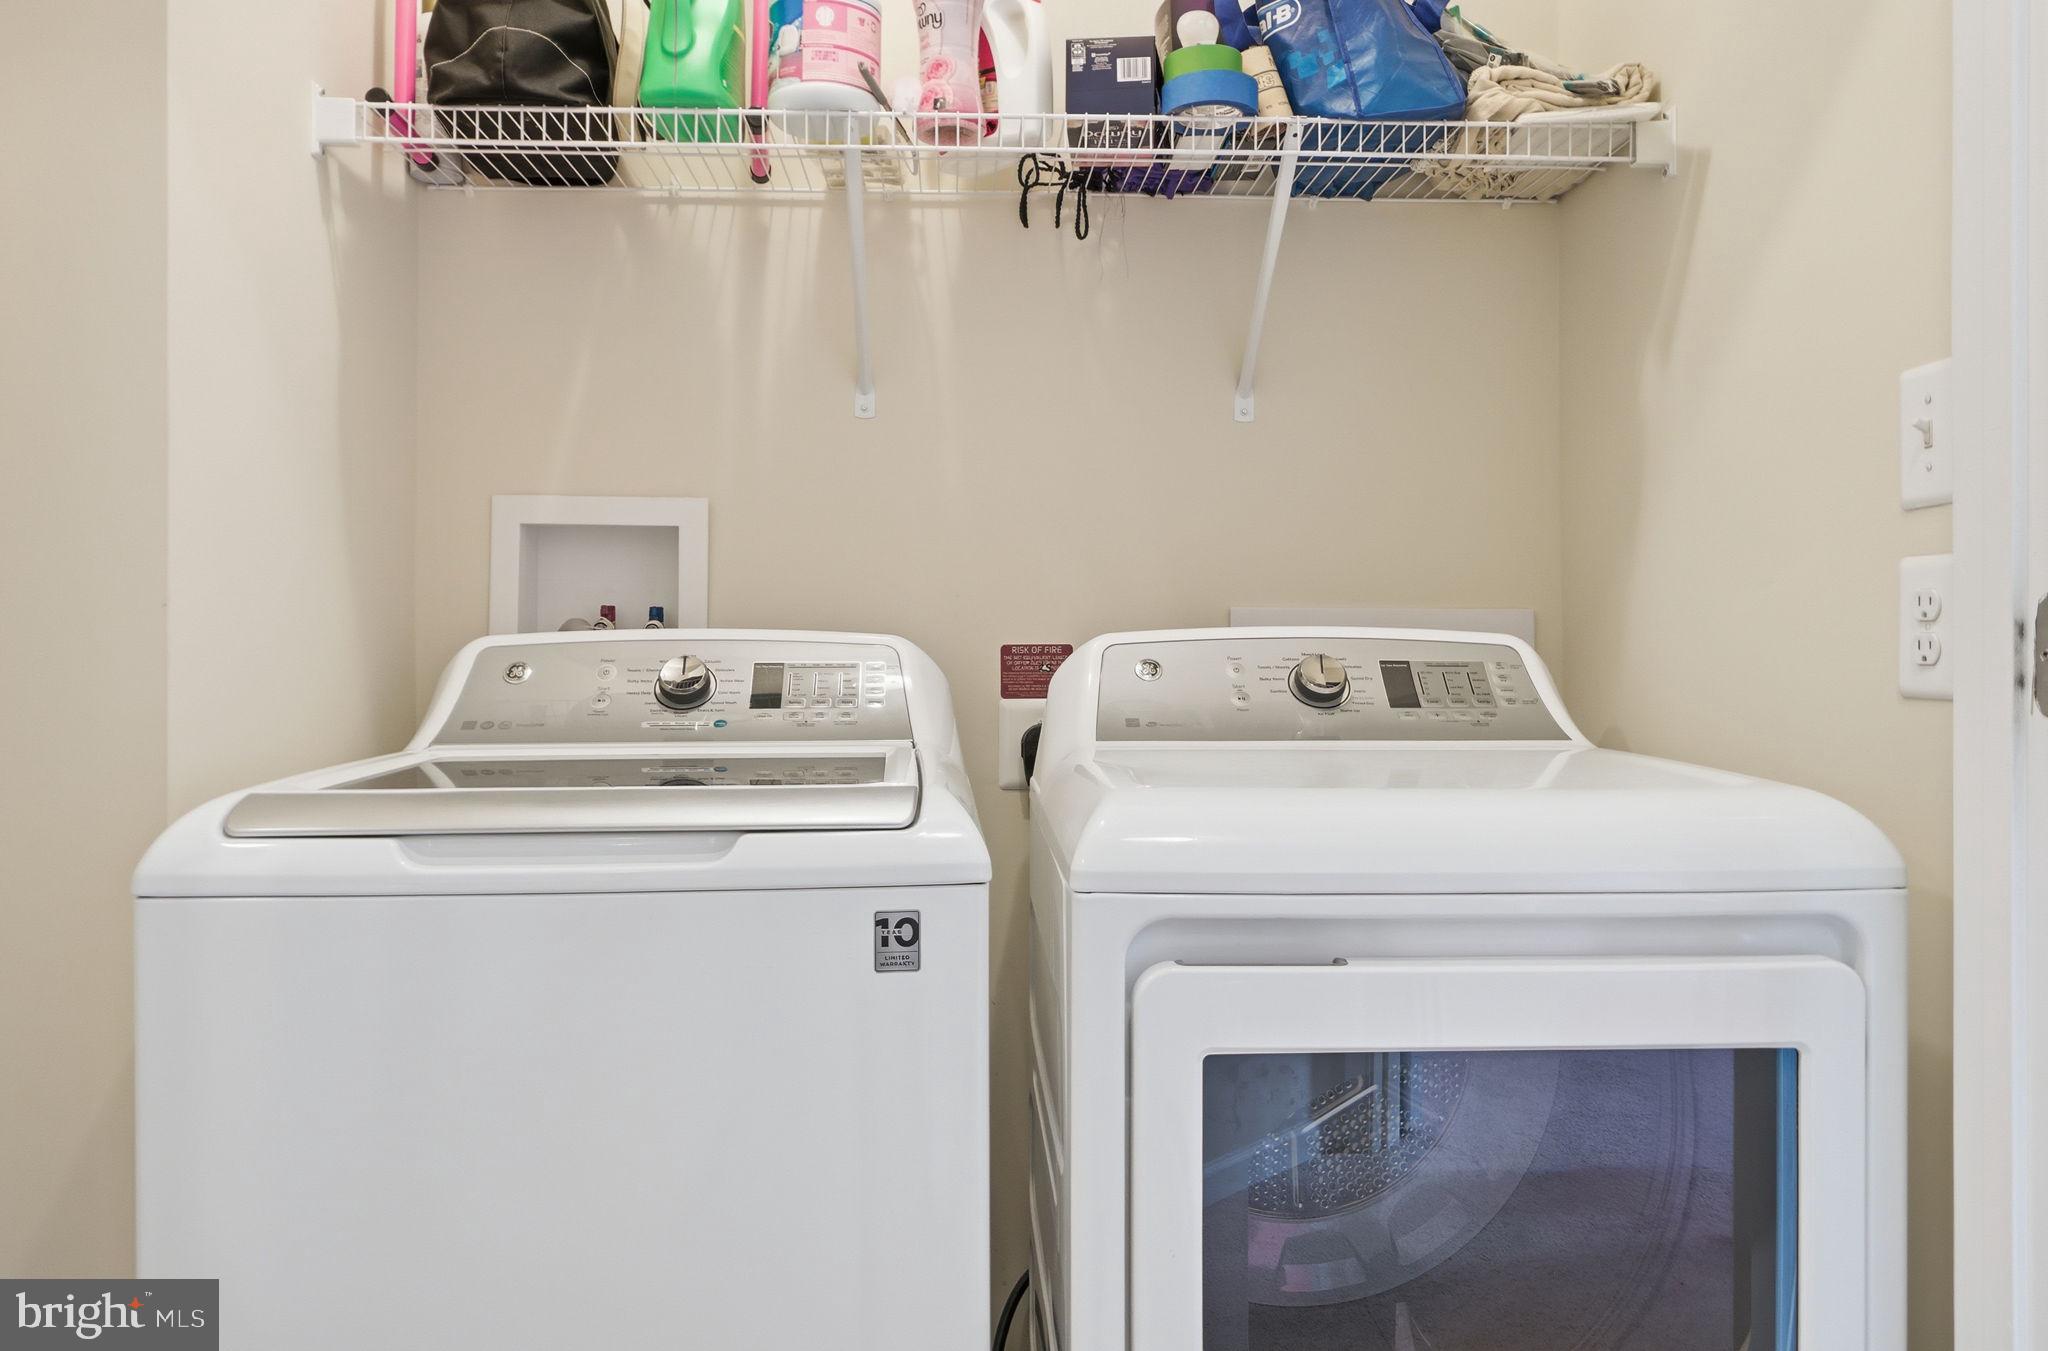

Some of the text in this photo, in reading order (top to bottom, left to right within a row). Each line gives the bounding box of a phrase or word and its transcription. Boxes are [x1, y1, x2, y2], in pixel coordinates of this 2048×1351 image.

[1011, 646, 1062, 654] RISK OF FIRE
[875, 917, 919, 947] 10
